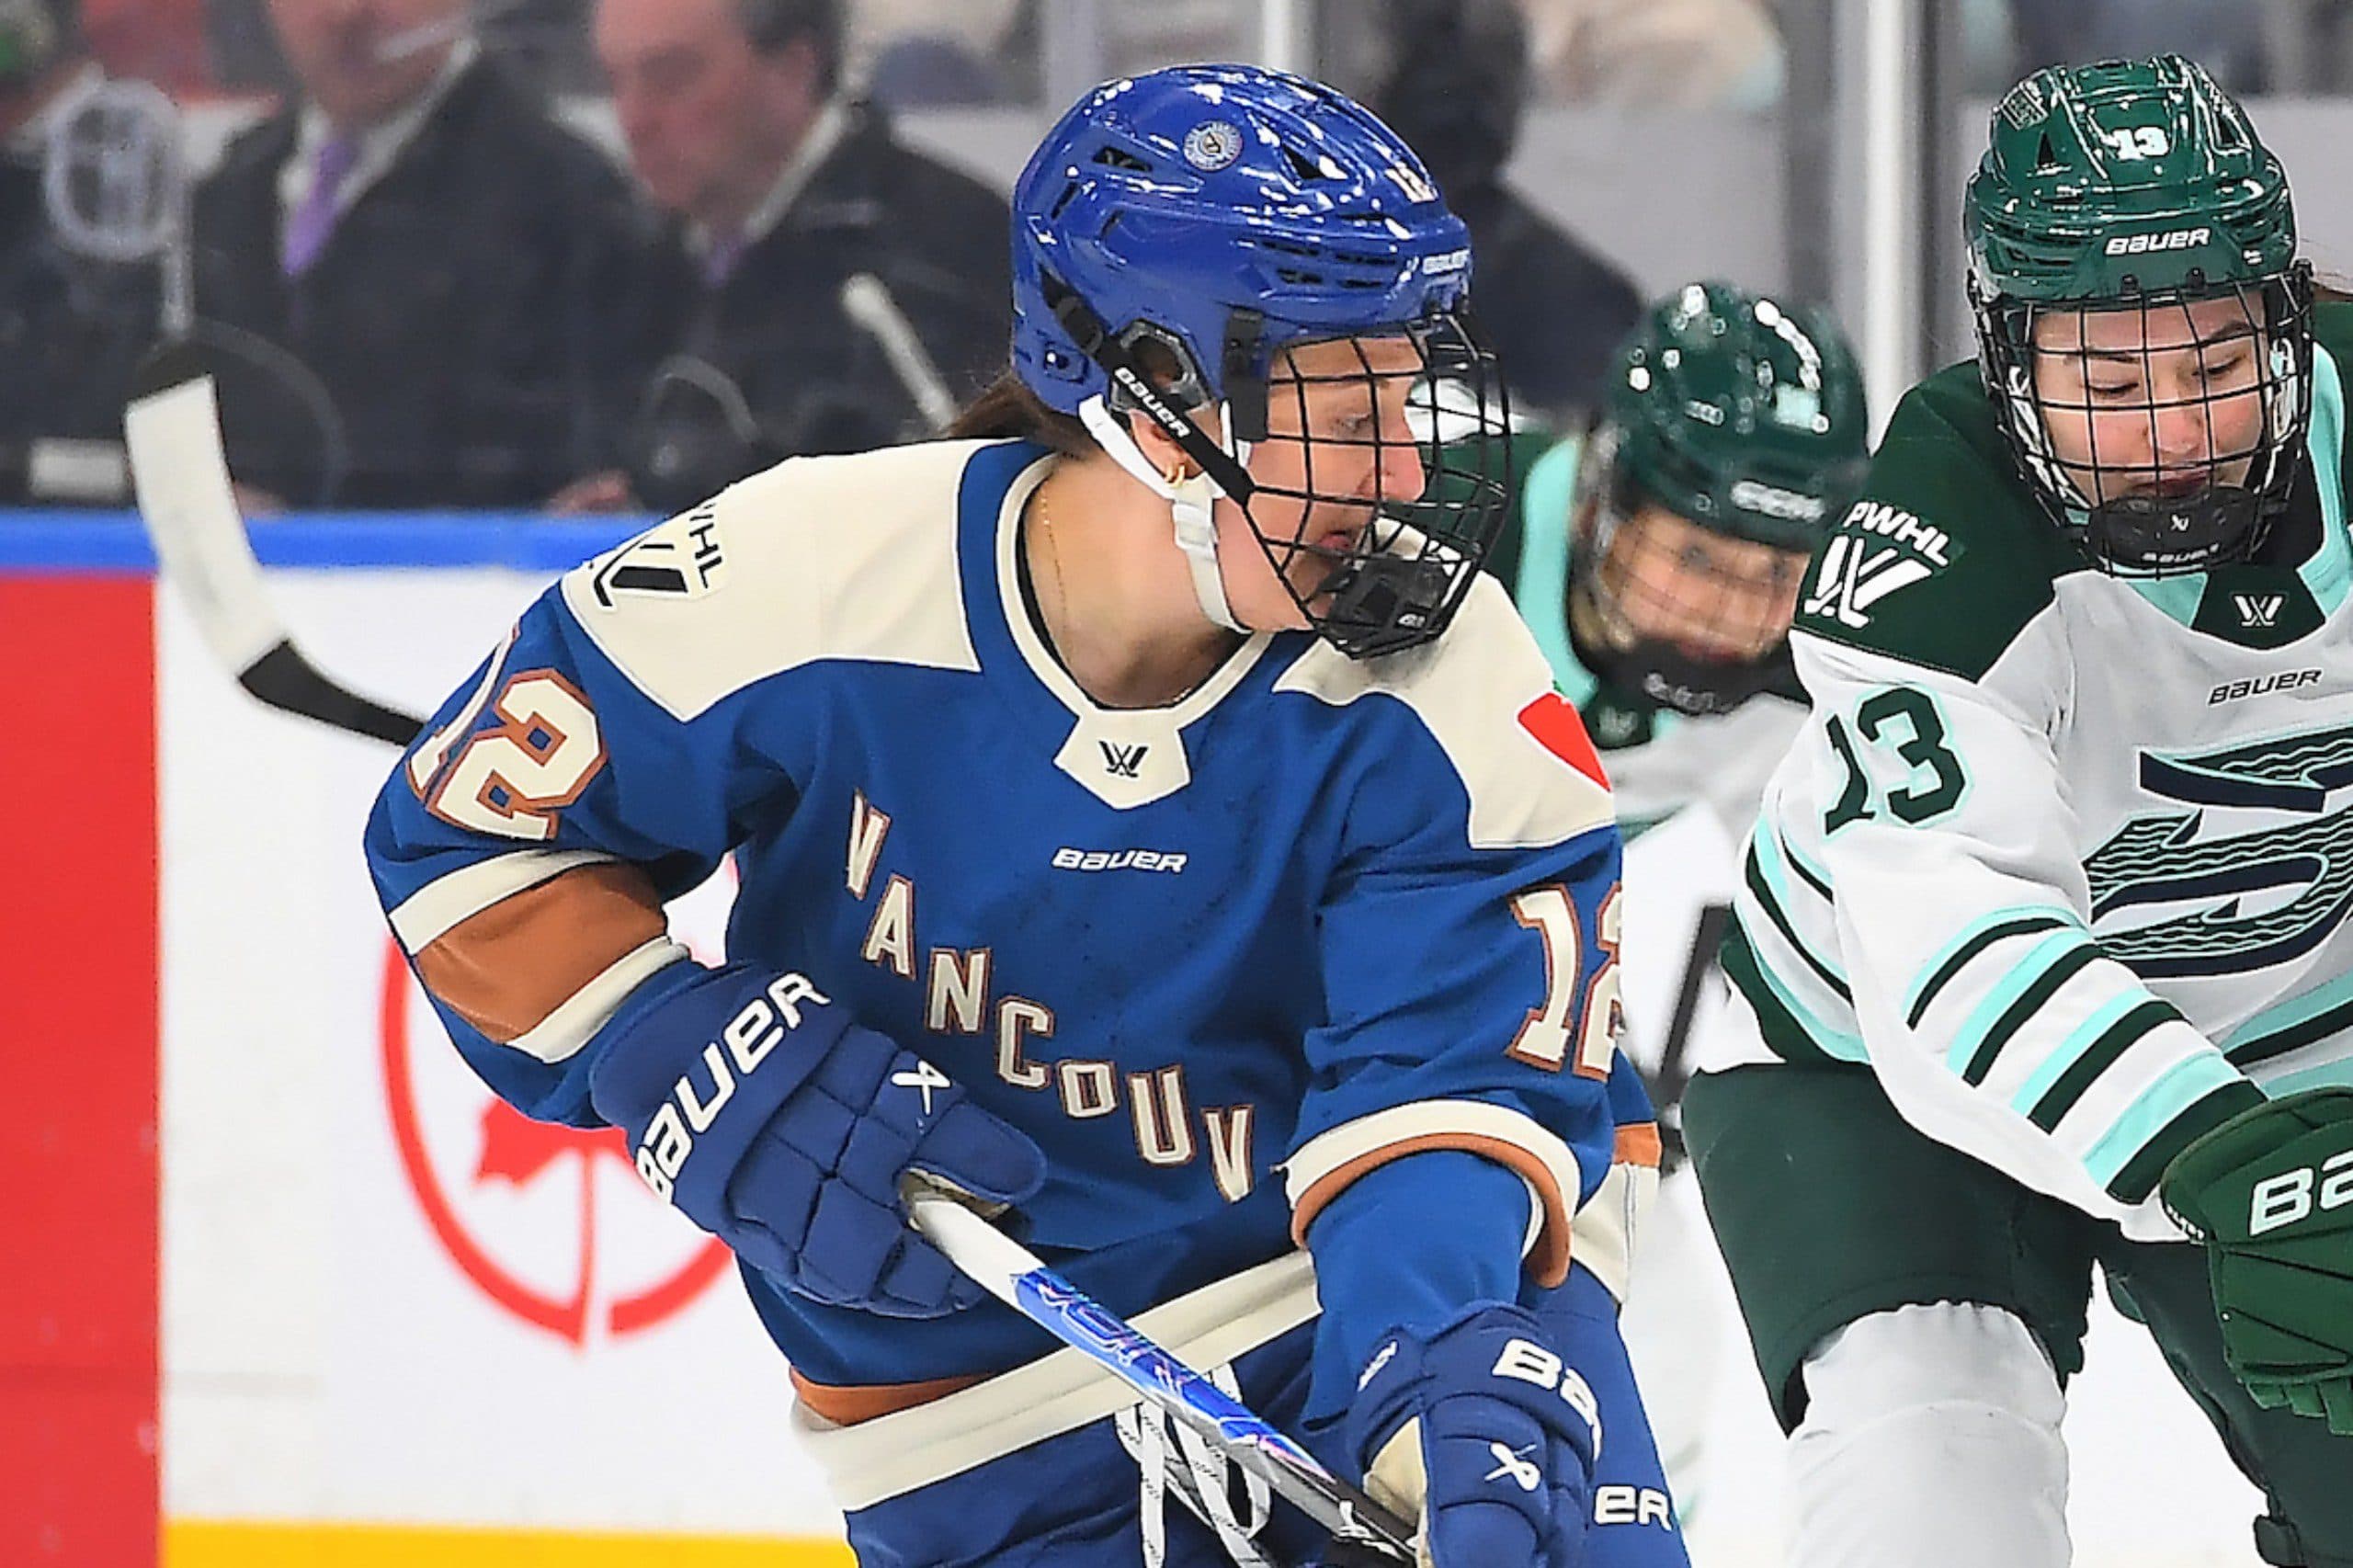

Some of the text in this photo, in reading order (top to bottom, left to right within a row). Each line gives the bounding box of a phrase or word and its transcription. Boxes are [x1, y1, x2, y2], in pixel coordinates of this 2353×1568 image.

[2112, 127, 2169, 161] 13
[1842, 501, 1949, 567] PWHL
[405, 622, 611, 840] 12
[1824, 684, 1969, 837] 13
[1492, 1337, 1602, 1462] BA
[1595, 1484, 1672, 1532] ER
